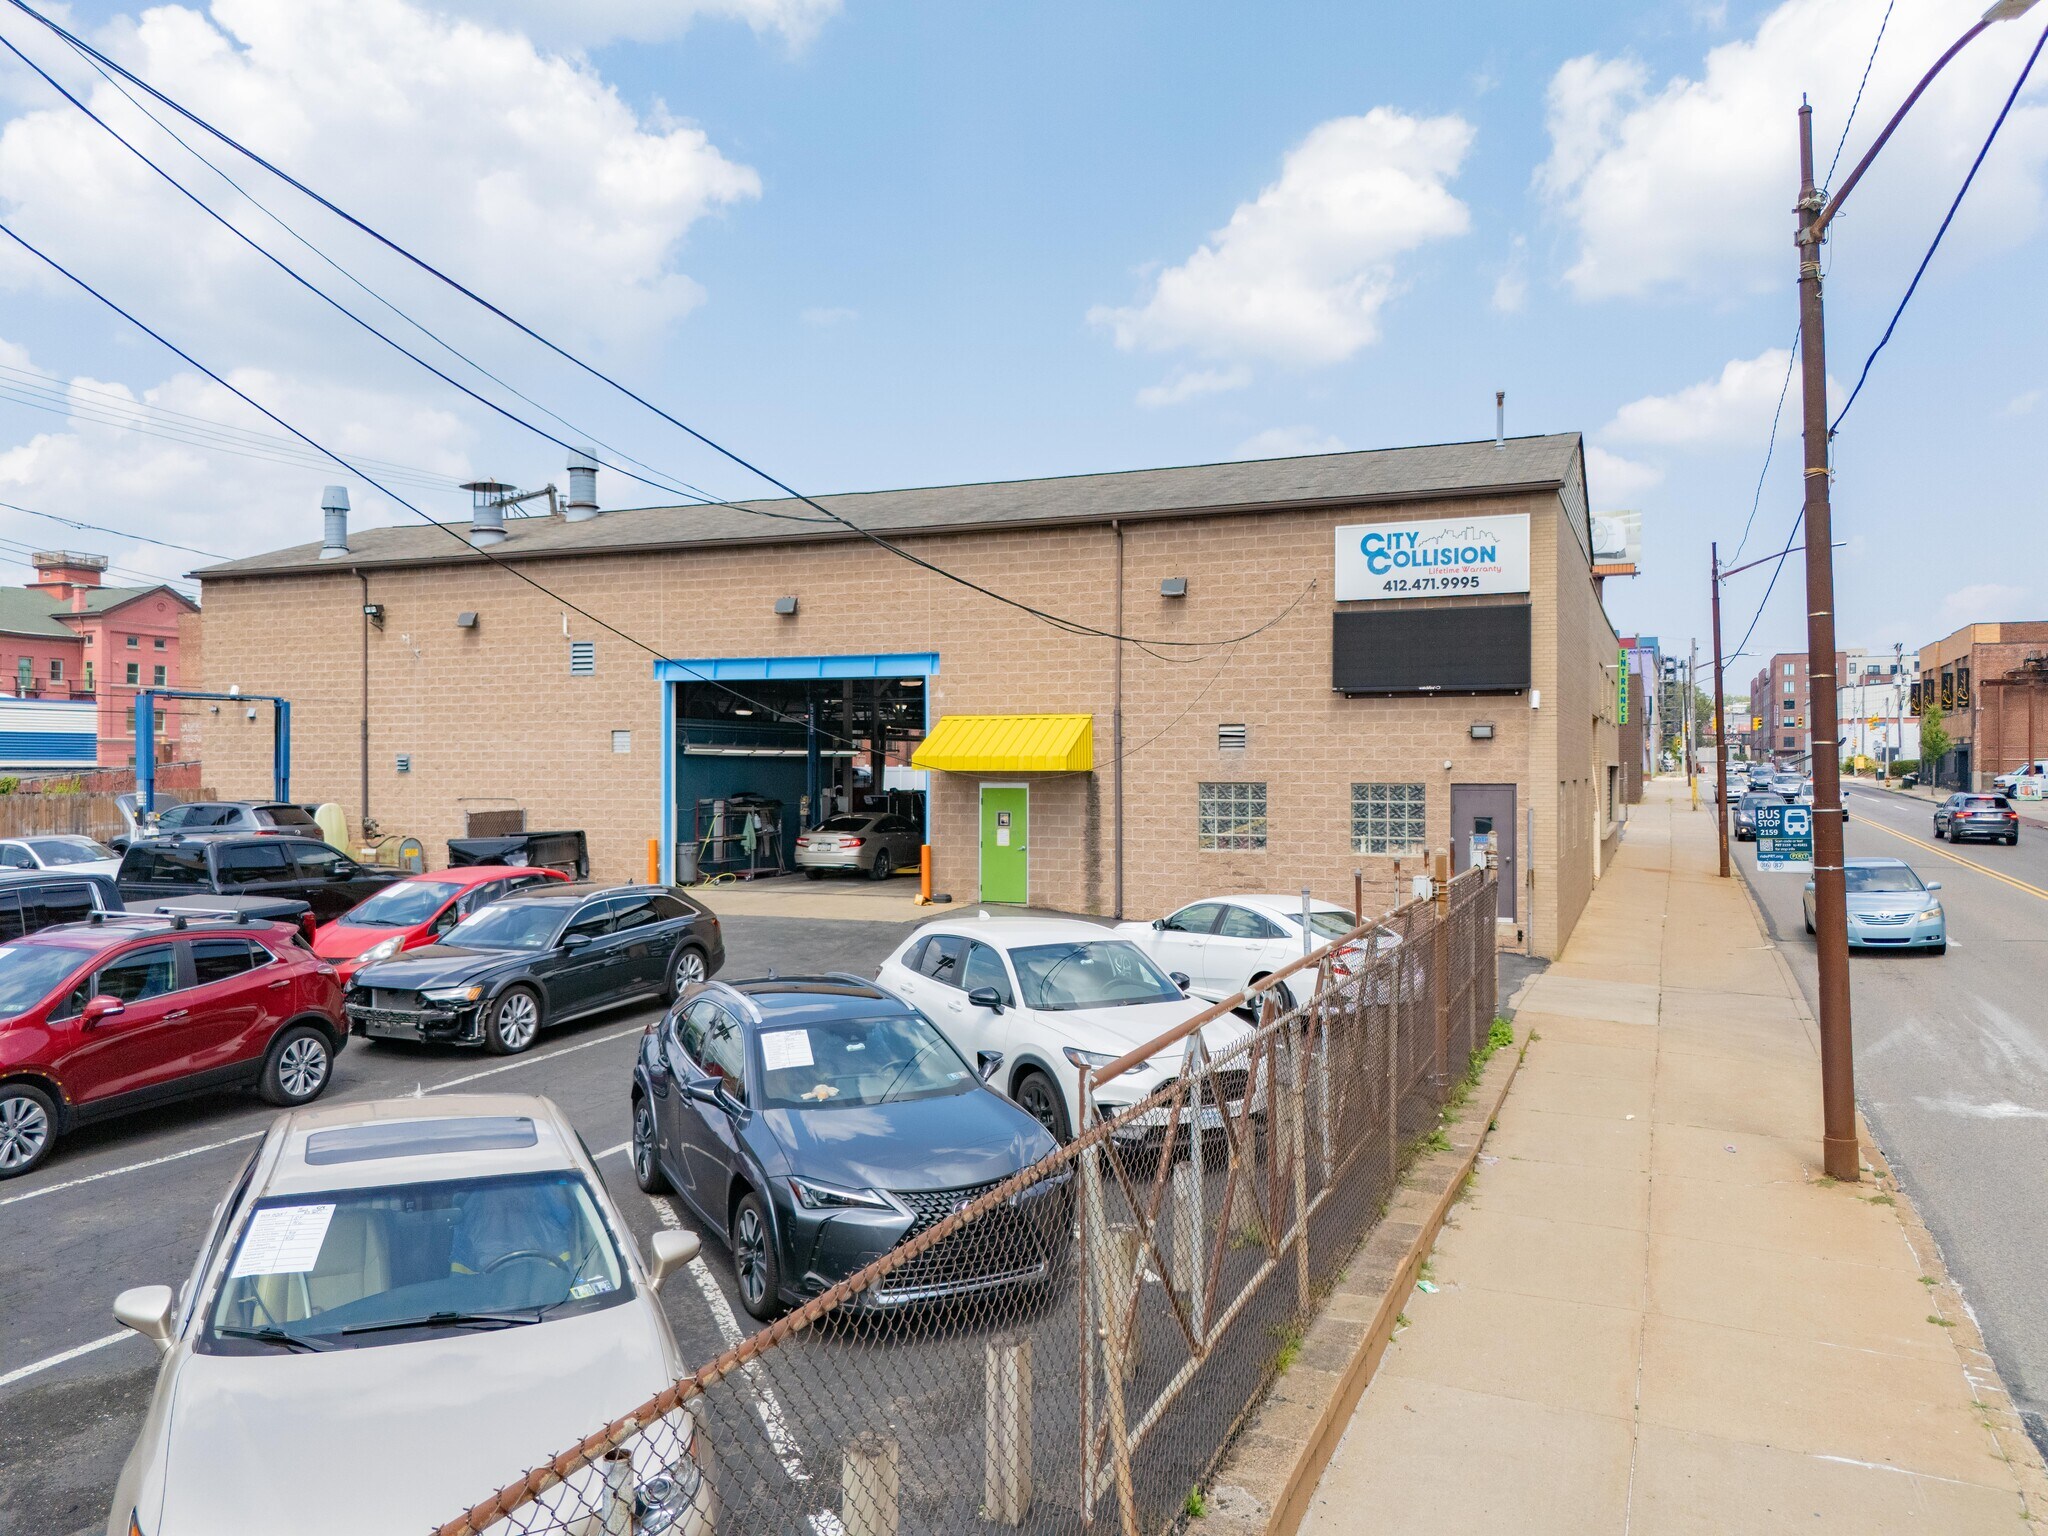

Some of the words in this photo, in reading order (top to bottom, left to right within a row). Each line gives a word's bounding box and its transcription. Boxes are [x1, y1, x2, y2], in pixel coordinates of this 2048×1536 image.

[1360, 532, 1419, 558] CITY
[1366, 545, 1496, 576] COLLISION
[1428, 566, 1460, 575] Lifetime
[1461, 565, 1502, 574] Warranty
[1382, 576, 1480, 592] 412.471.9995
[1758, 809, 1780, 819] BUS
[1758, 819, 1780, 827] STOP
